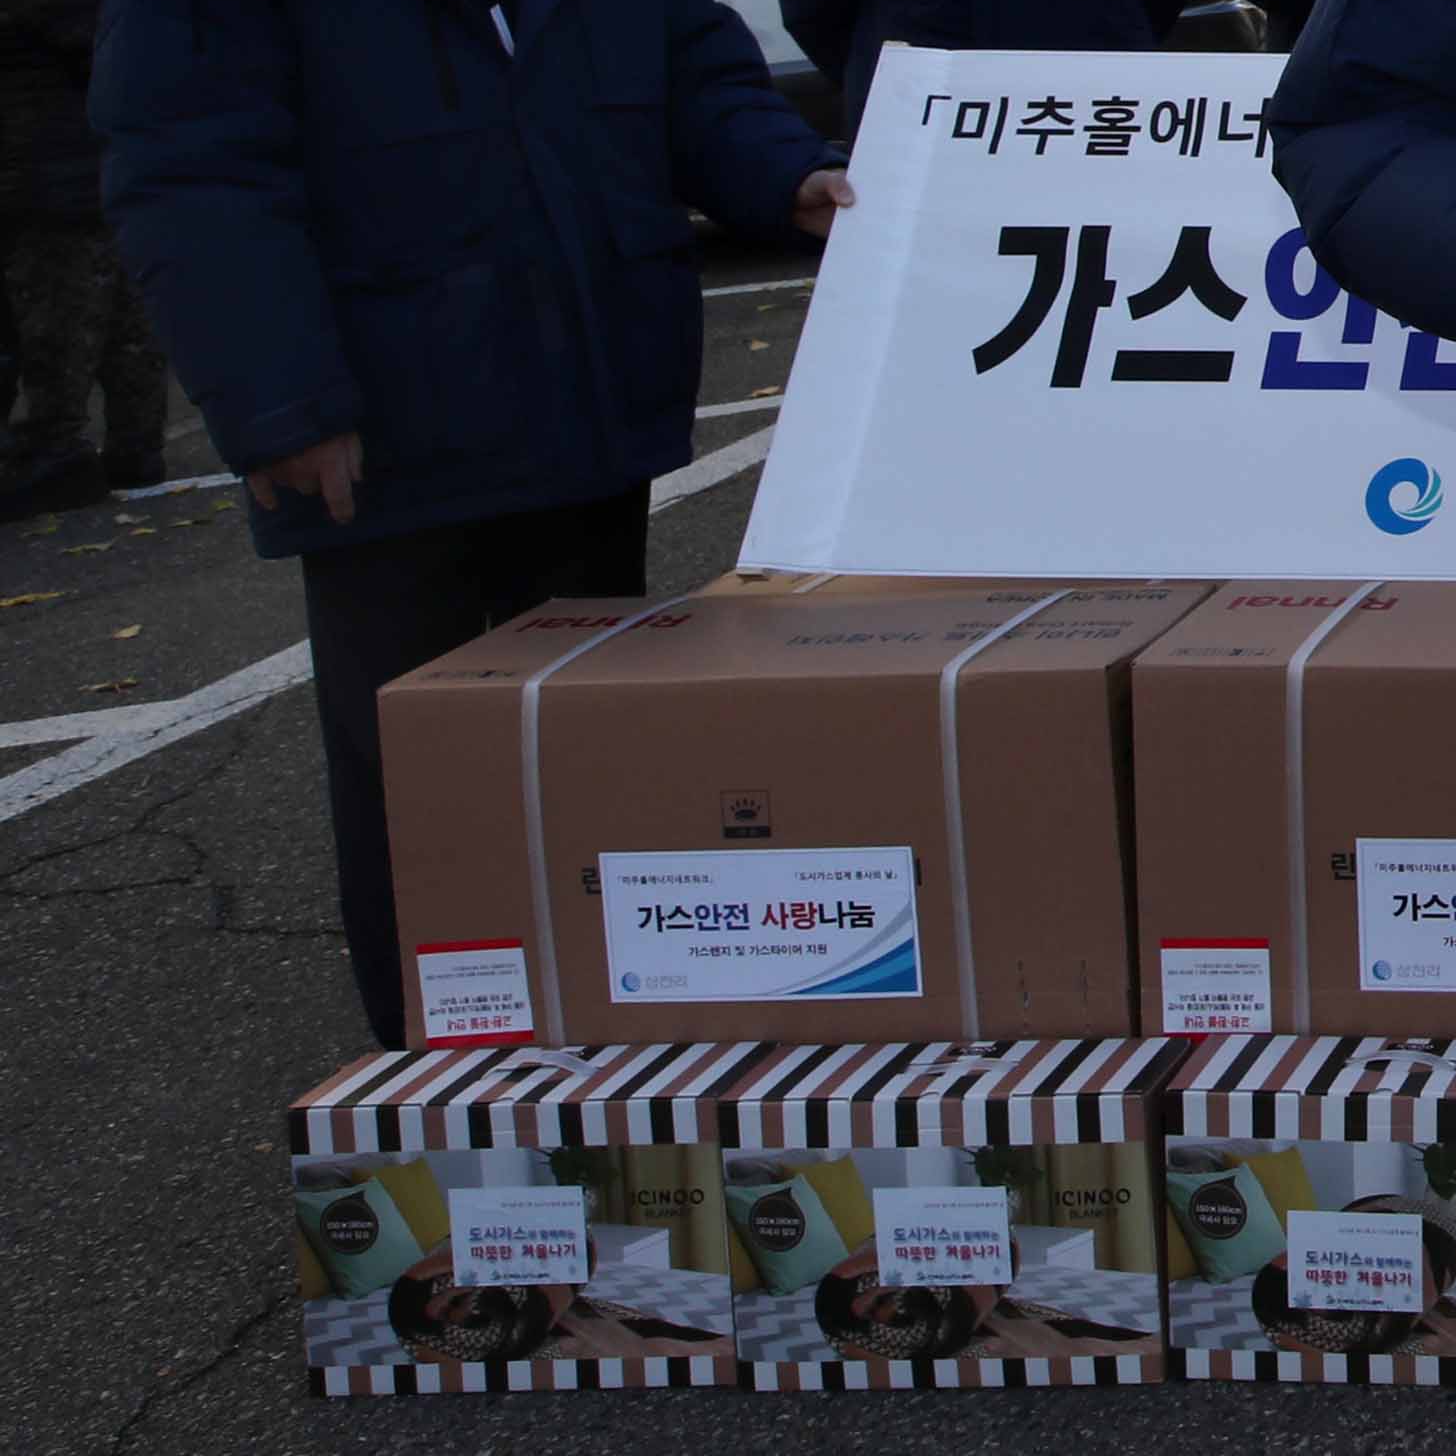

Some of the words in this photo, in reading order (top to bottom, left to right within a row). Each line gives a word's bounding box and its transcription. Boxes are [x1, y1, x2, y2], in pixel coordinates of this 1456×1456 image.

[1226, 595, 1399, 612] Rnnai
[515, 612, 692, 634] Rnnai
[637, 902, 751, 933] 가스안전
[760, 900, 877, 931] 사랑나눔
[470, 1244, 514, 1261] 따뜻한
[521, 1244, 578, 1260] 겨울나기
[894, 1245, 937, 1261] 따뜻한
[945, 1245, 1001, 1261] 겨울나기
[1304, 1269, 1348, 1287] 따뜻한
[1357, 1269, 1413, 1287] 겨울나기
